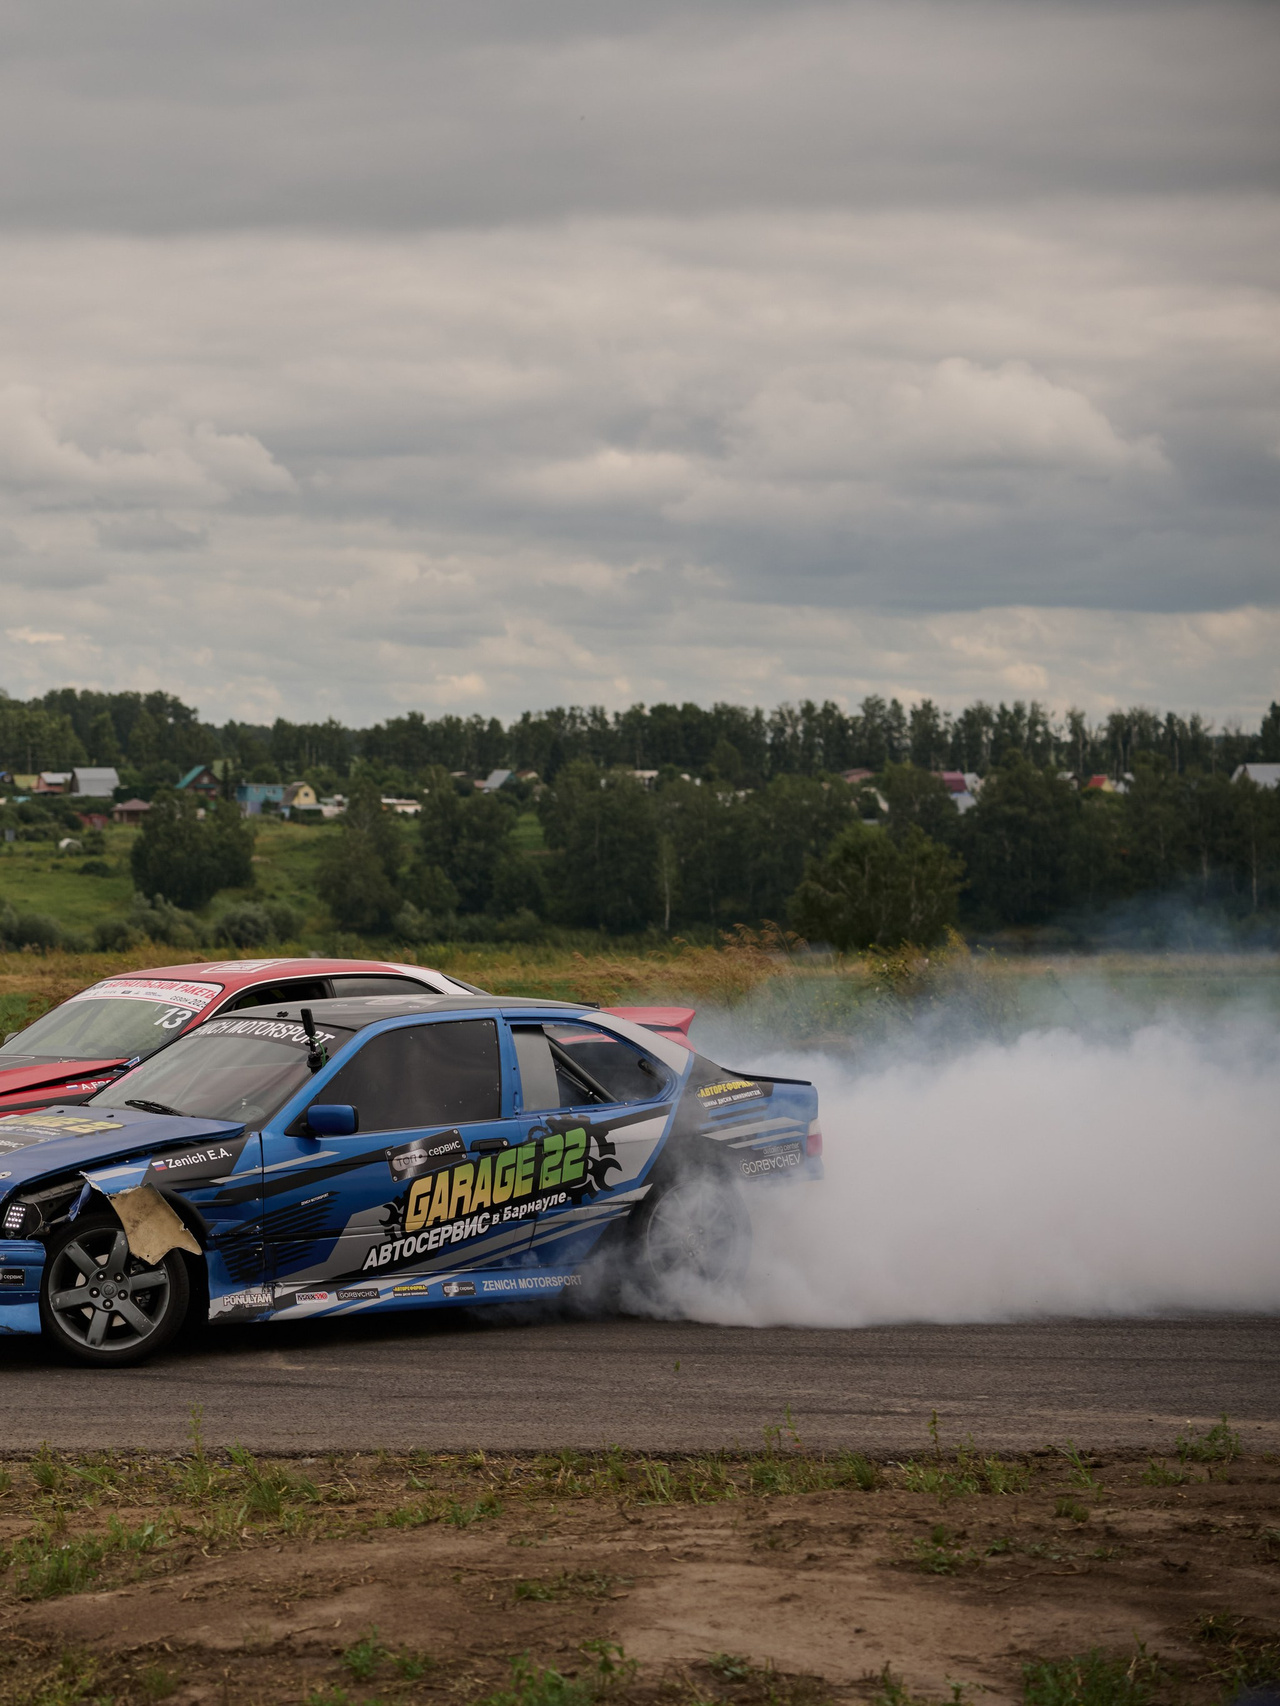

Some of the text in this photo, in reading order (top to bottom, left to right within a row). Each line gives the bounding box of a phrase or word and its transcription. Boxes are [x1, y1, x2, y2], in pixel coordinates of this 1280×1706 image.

[153, 1007, 192, 1029] 13
[165, 1147, 233, 1169] Zenich E.A.
[428, 1140, 461, 1156] сервис
[404, 1127, 587, 1233] GARAGE 22
[362, 1191, 568, 1271] АВТОСЕРВИС в Барнауле
[482, 1275, 582, 1292] ZENICH MOTORSPORT
